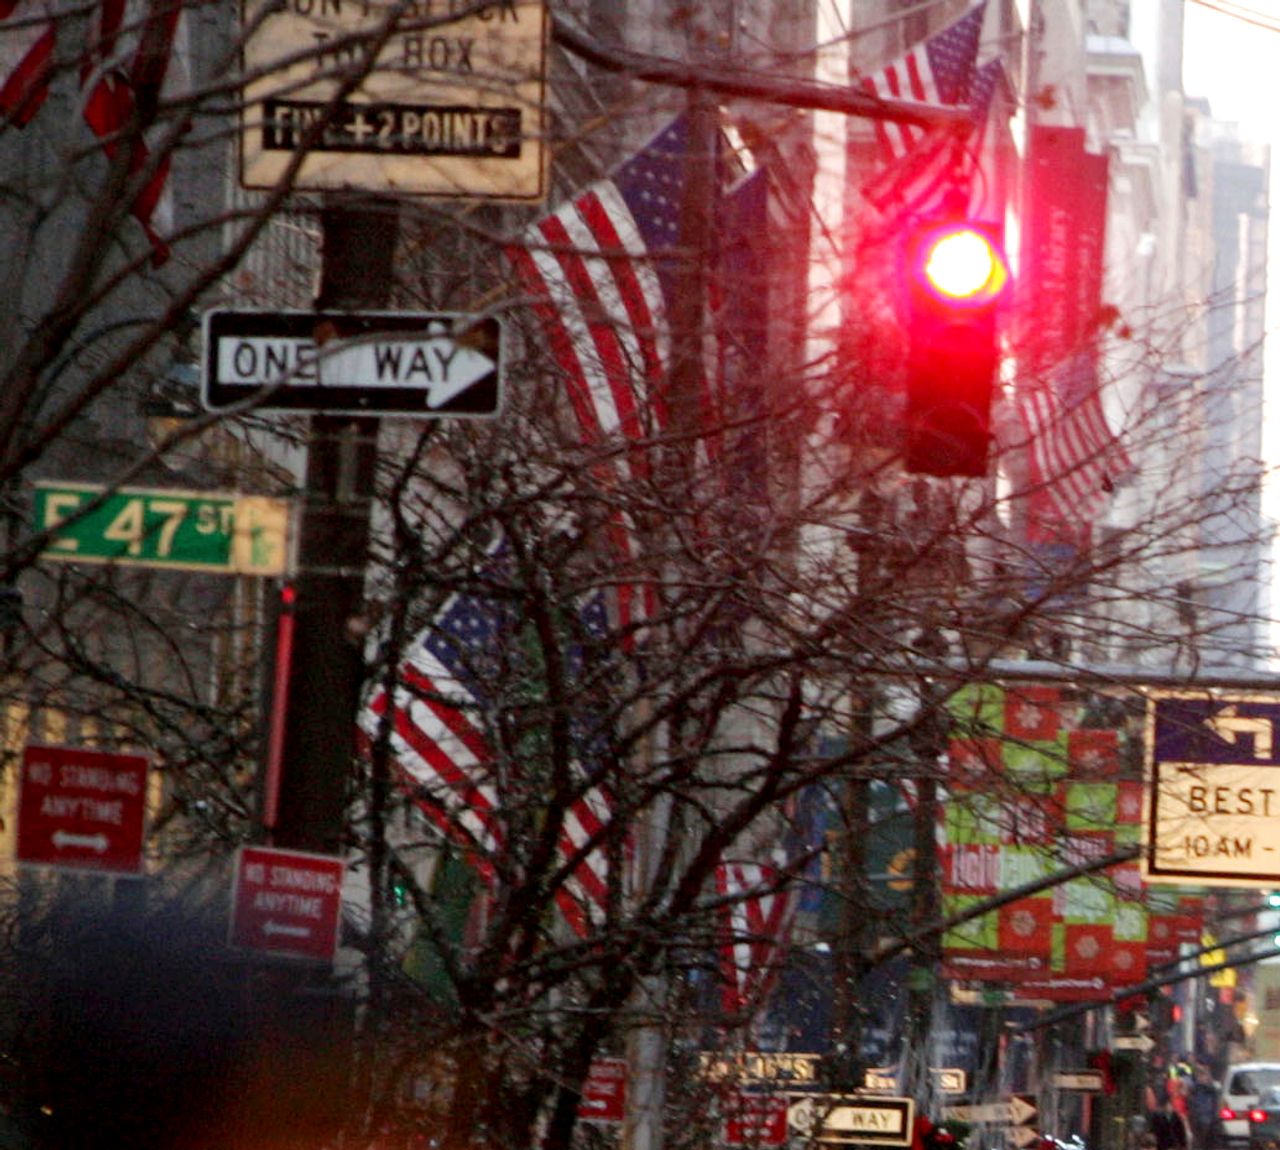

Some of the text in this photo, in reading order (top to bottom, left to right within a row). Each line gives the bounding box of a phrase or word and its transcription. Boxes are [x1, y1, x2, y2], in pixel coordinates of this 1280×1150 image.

[404, 36, 475, 72] BOX
[402, 113, 508, 154] POINTS
[233, 342, 458, 381] ONE WAY
[44, 494, 80, 551] E
[104, 501, 187, 557] 47
[40, 795, 124, 826] ANYTIME
[1189, 785, 1276, 817] BEST
[1185, 834, 1253, 859] 10AM
[245, 862, 337, 895] NO STANDING
[254, 892, 323, 920] ANYTIME
[851, 1110, 893, 1129] WAY
